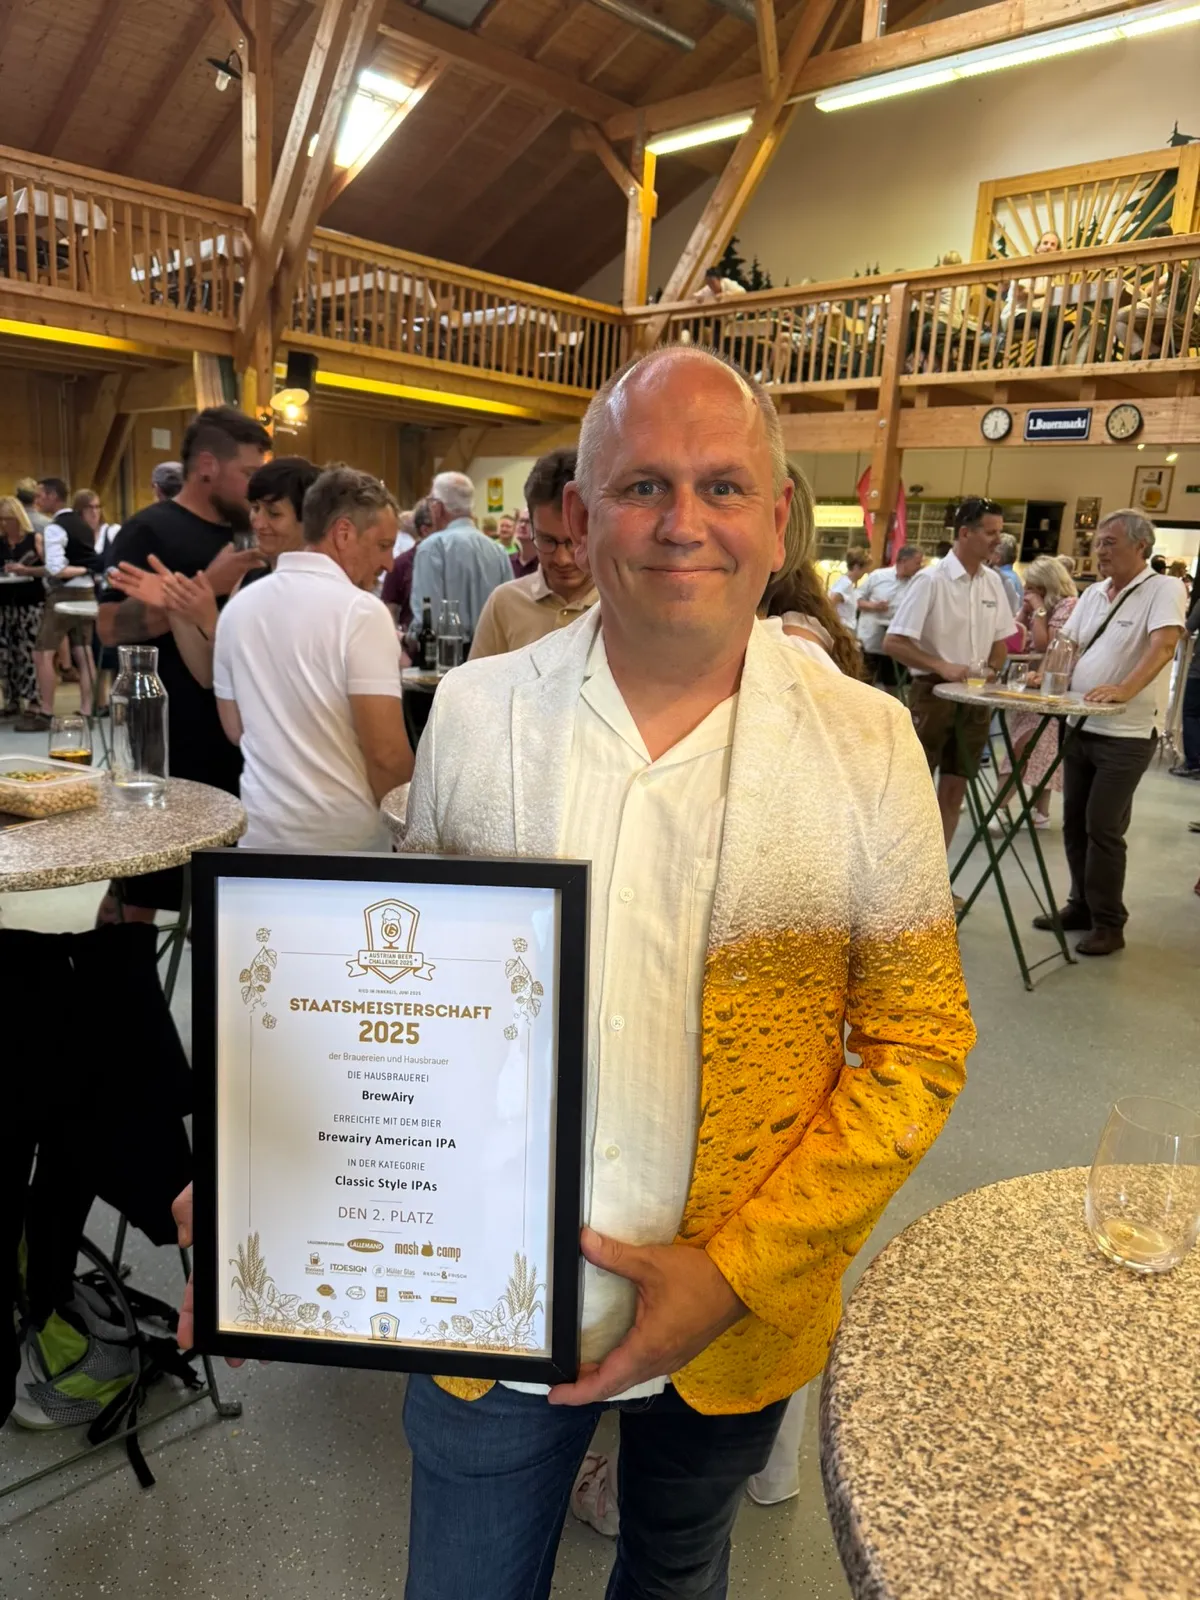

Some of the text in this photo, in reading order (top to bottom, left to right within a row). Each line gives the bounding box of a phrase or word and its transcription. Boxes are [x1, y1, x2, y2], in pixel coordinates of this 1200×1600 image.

[290, 998, 492, 1020] STAATSMEISTERSCHAFT
[358, 1020, 420, 1044] 2025
[328, 1052, 449, 1065] der Brauereien und Hausbrauer
[347, 1070, 429, 1083] DIE HAUSBRAUEREI
[362, 1090, 414, 1105] BrewAiry
[333, 1114, 442, 1128] ERREICHTE MIT DEM BIER
[318, 1131, 456, 1149] Brewairy American IPA
[347, 1158, 425, 1171] IN DER KATEGORIE
[335, 1175, 437, 1192] Classic Style IPAs
[338, 1206, 434, 1225] DEN 2. PLATZ
[350, 1241, 382, 1250] LALLEMAND
[395, 1241, 461, 1262] mash camp
[404, 1268, 415, 1276] Glas
